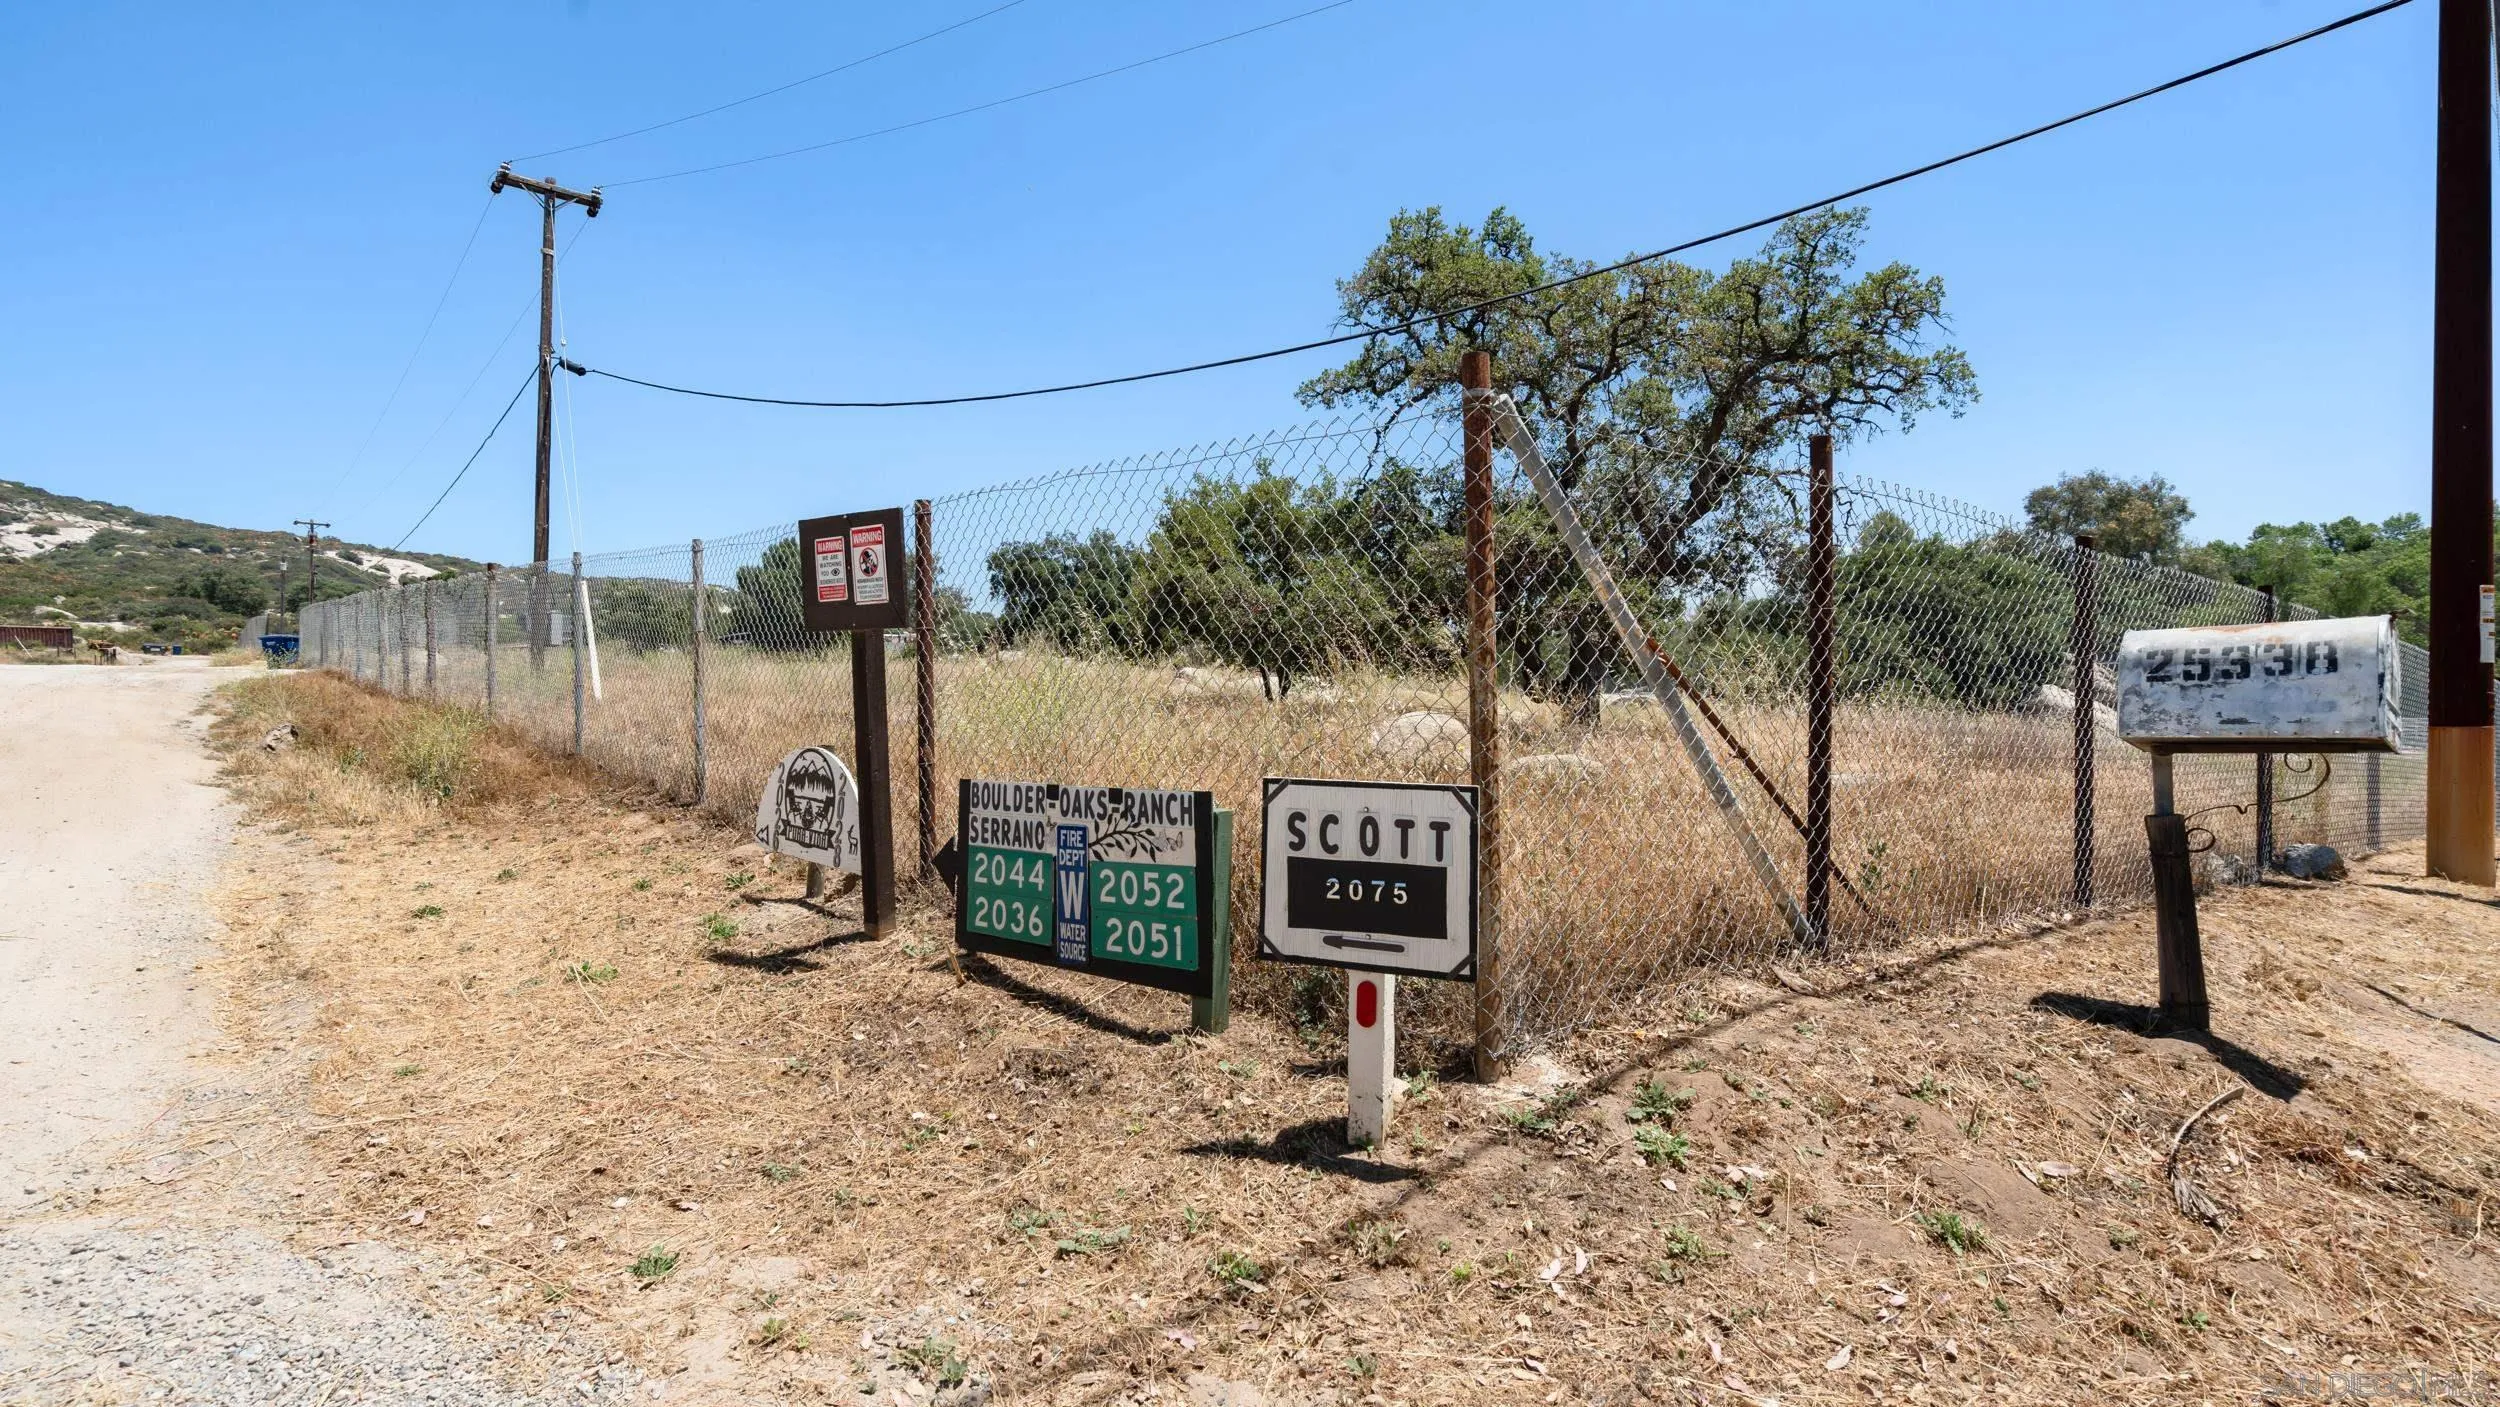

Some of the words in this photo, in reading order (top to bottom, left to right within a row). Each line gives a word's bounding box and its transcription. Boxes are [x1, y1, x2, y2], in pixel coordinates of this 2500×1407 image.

[817, 540, 842, 553] WARNING
[853, 531, 882, 545] WARNING
[970, 816, 1045, 850] SERRANO
[1060, 829, 1084, 848] FIRE
[1287, 811, 1451, 862] SCOTT
[974, 853, 1045, 891] 2044
[1059, 849, 1085, 867] DEPT
[1060, 871, 1085, 920] W
[1099, 869, 1185, 909] 2052
[1326, 878, 1408, 905] 2075
[974, 897, 1044, 936] 2036
[1060, 922, 1086, 942] WATER
[1106, 918, 1182, 960] 2051
[1060, 942, 1086, 962] SOURCE
